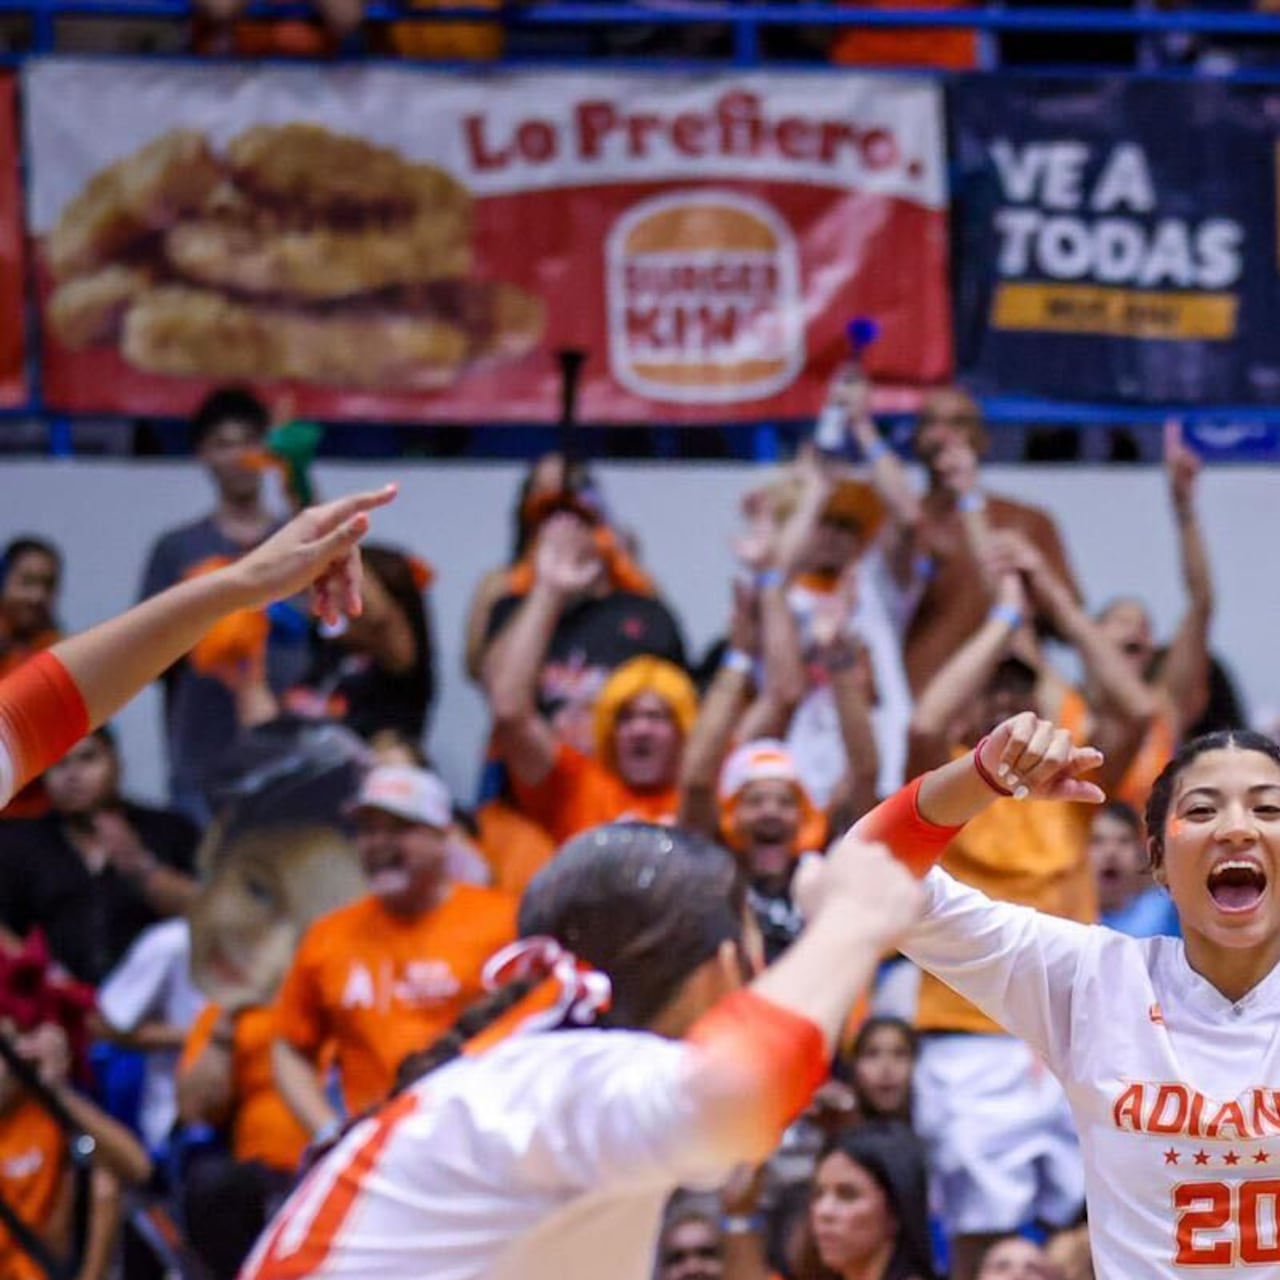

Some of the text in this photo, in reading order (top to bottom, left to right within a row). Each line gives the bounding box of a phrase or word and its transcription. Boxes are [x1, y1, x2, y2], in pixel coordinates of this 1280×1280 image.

[462, 88, 924, 179] Lo Prefiero.
[990, 141, 1155, 211] VE A
[995, 210, 1244, 288] TODAS
